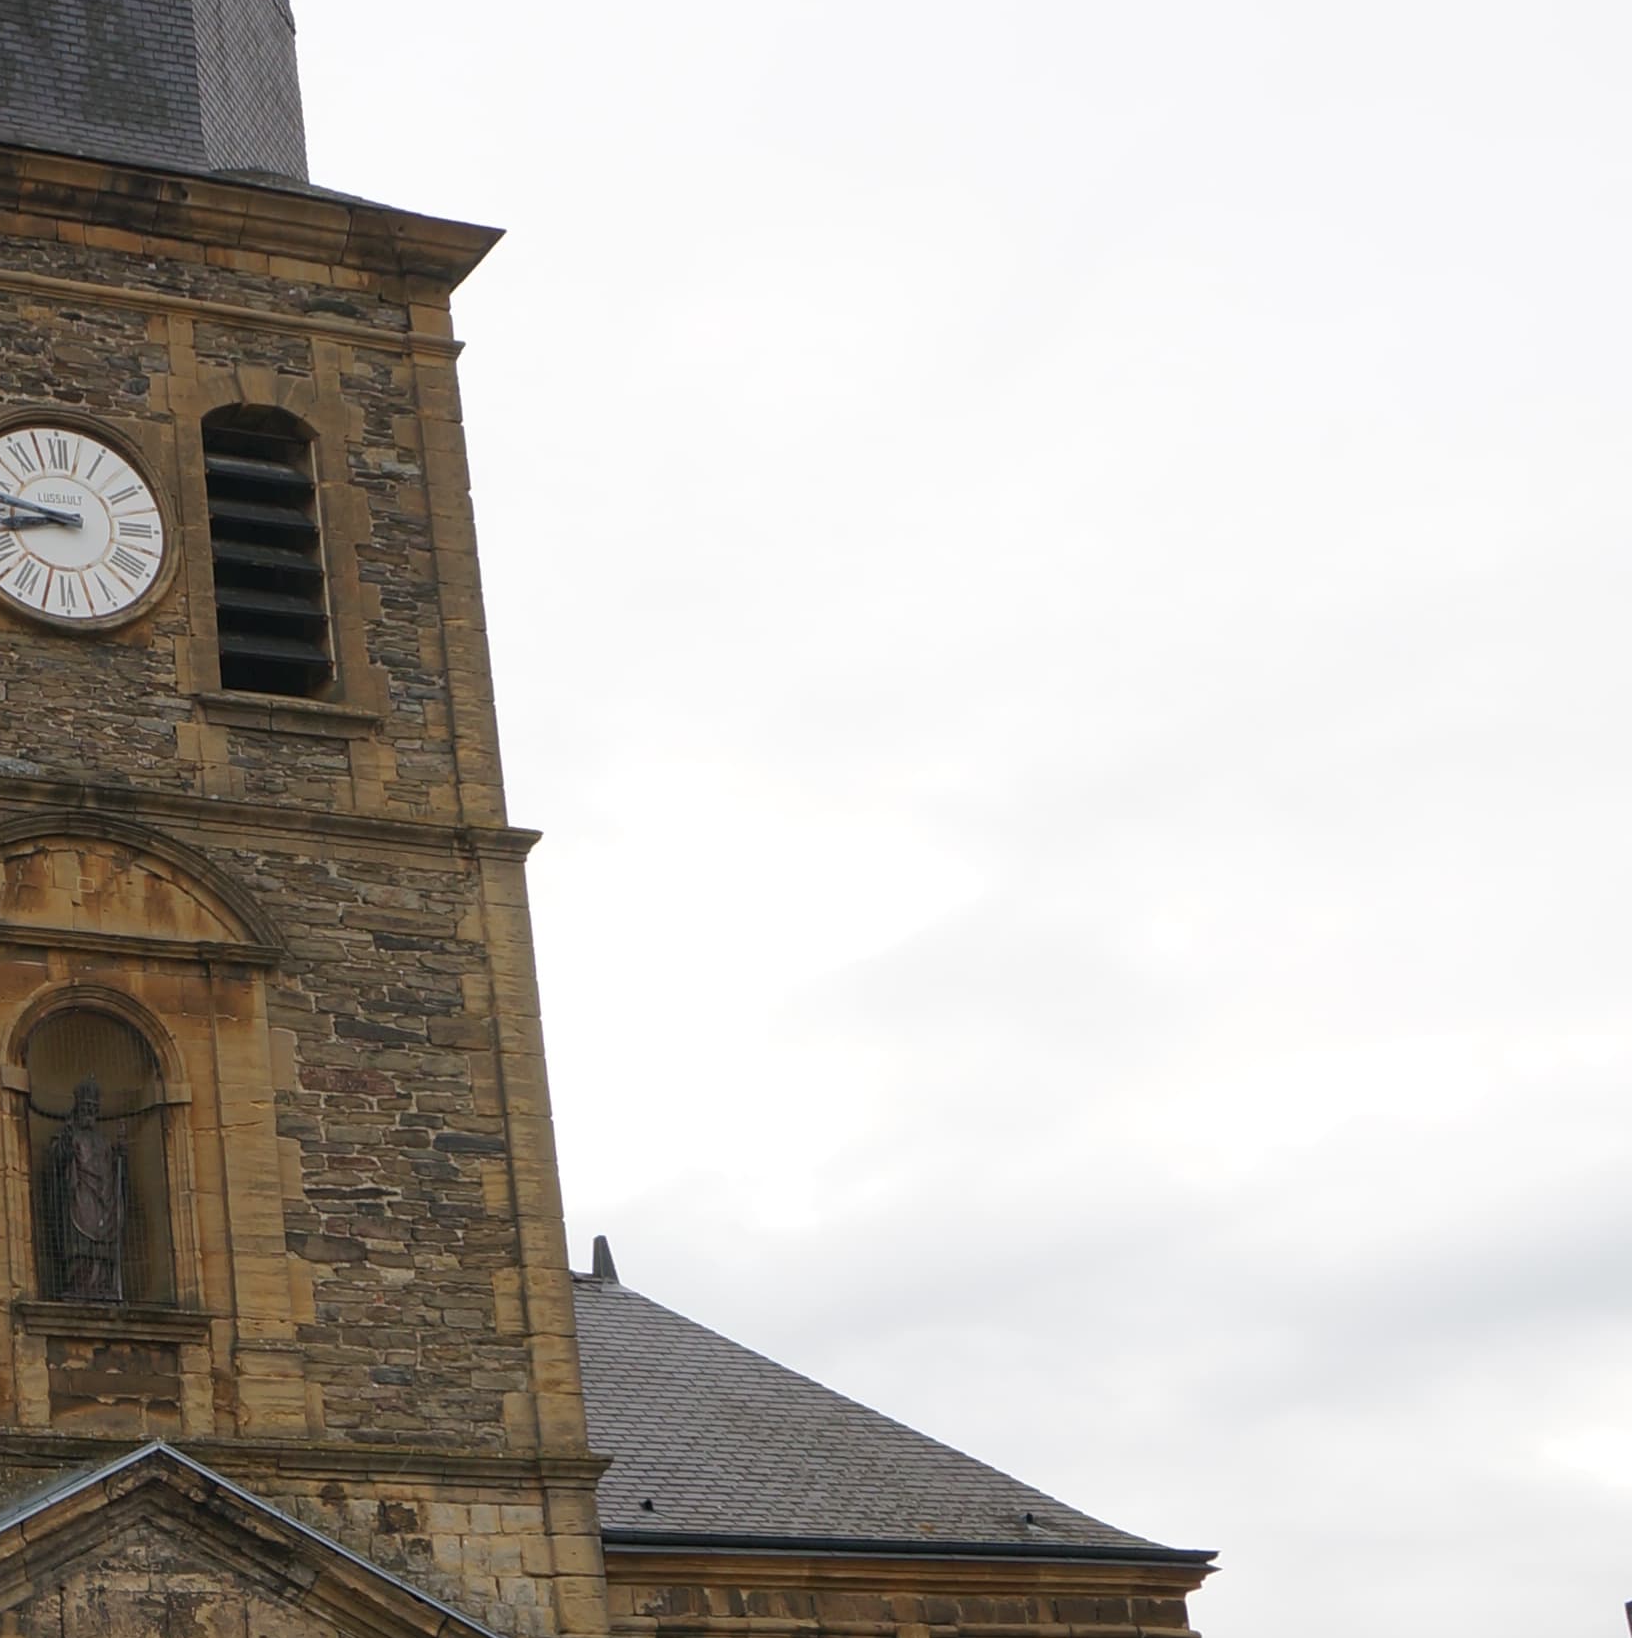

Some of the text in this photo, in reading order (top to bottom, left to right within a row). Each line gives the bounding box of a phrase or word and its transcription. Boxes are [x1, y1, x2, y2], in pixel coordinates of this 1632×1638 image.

[7, 441, 37, 477] XI
[47, 438, 69, 471] XII
[37, 491, 83, 506] LUSSAULT
[107, 484, 139, 506] II
[118, 521, 153, 539] III
